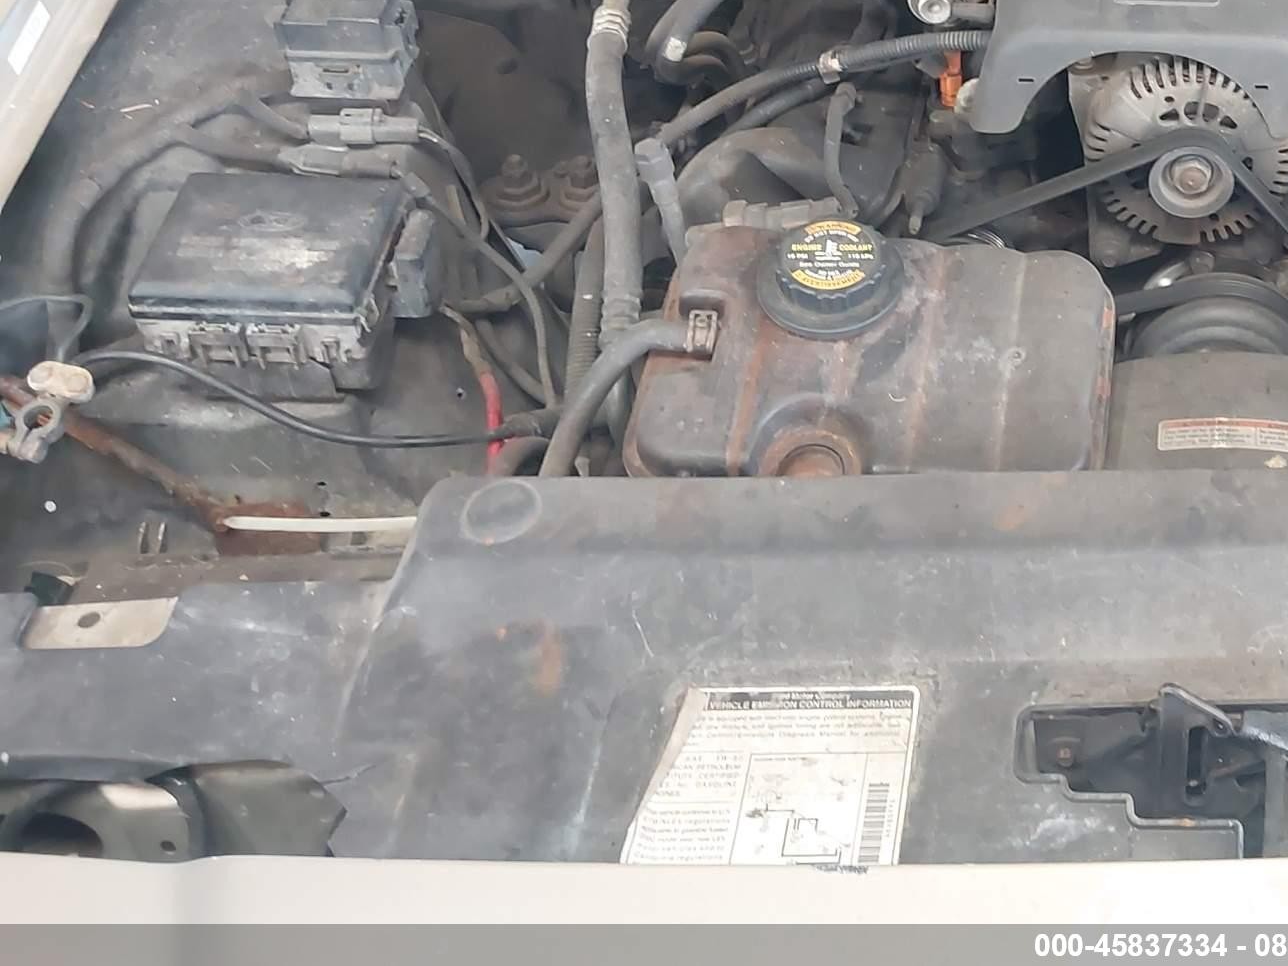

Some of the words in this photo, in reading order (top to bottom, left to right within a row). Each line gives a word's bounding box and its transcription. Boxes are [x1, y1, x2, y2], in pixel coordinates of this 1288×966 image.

[791, 244, 822, 252] ENGINE
[839, 244, 873, 252] COOLANT
[710, 700, 750, 710] VEHICLE
[799, 699, 843, 709] CONTROL
[847, 699, 911, 709] INFORMATION
